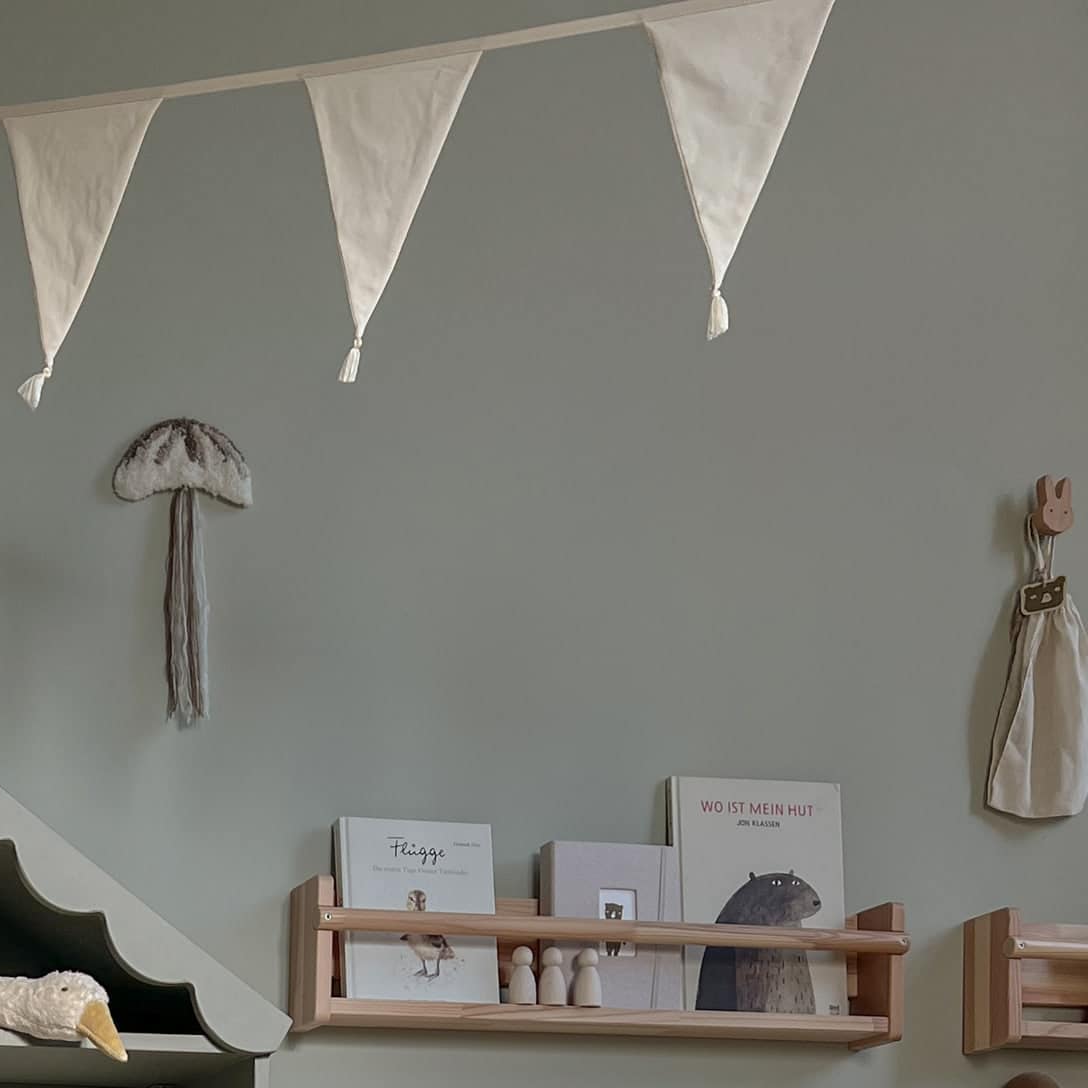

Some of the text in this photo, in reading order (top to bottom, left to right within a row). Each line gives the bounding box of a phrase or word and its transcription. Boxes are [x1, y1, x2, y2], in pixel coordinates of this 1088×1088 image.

[700, 800, 814, 817] WO IST MEIN HUT
[752, 820, 781, 828] KLASSEN
[386, 836, 446, 866] Flügge
